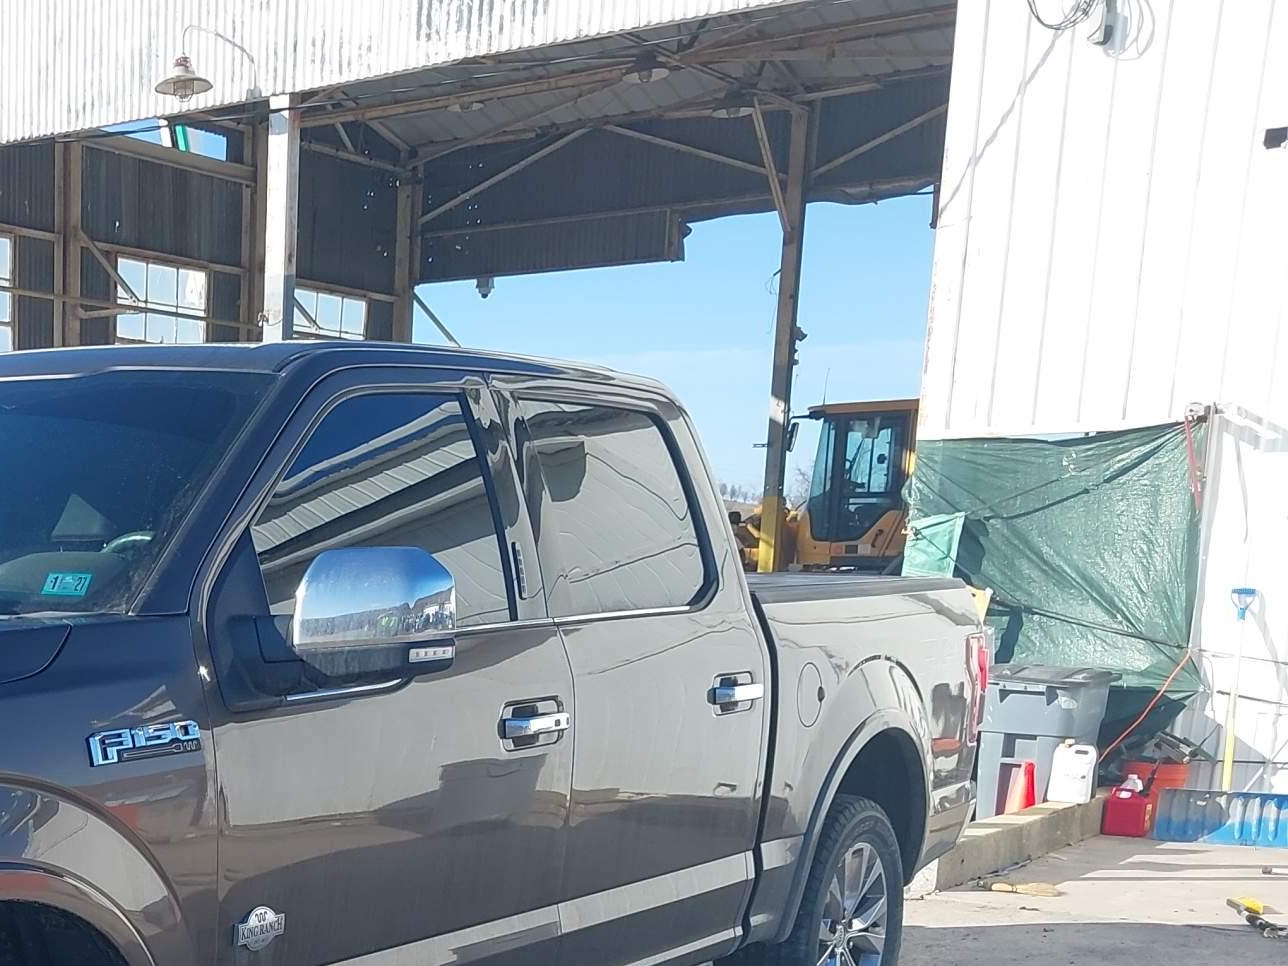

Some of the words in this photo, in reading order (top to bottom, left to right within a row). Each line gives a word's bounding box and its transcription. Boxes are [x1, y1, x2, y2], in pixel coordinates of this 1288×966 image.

[74, 576, 88, 592] 27
[241, 926, 259, 941] KING
[259, 916, 284, 936] RANCH
